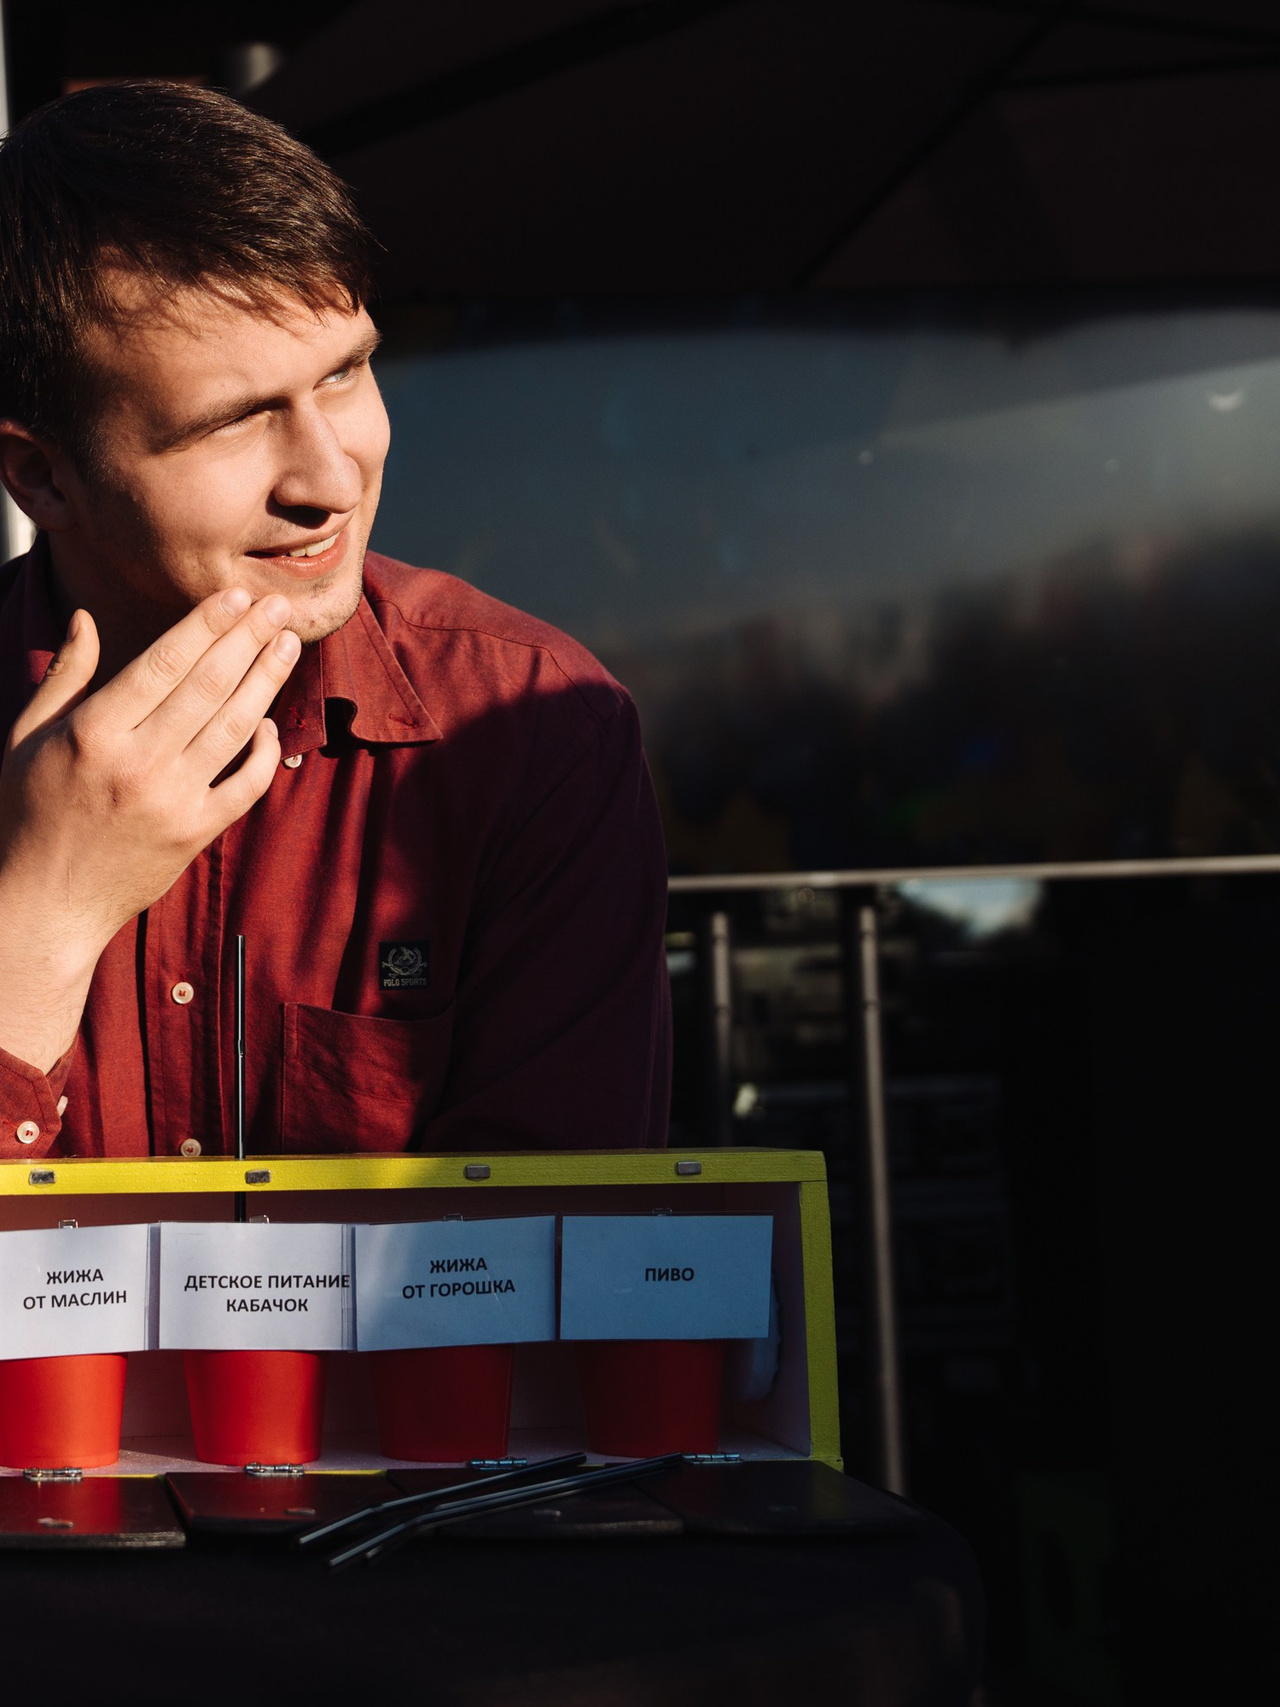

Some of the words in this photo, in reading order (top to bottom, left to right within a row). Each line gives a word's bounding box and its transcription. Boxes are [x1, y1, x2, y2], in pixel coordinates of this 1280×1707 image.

[383, 979, 400, 987] POLO
[401, 977, 427, 986] SPORTS
[429, 1257, 488, 1275] ЖИЖА
[644, 1267, 695, 1282] ПИВО
[46, 1268, 104, 1285] ЖИЖА
[183, 1274, 263, 1292] ДЕТСКОЕ
[268, 1274, 350, 1289] ПИТАНИЕ
[401, 1284, 426, 1300] ОТ
[429, 1278, 516, 1298] ГОРОШКА
[22, 1295, 47, 1310] ОТ
[51, 1290, 127, 1309] МАСЛИН
[226, 1298, 309, 1313] КАБАЧОК
